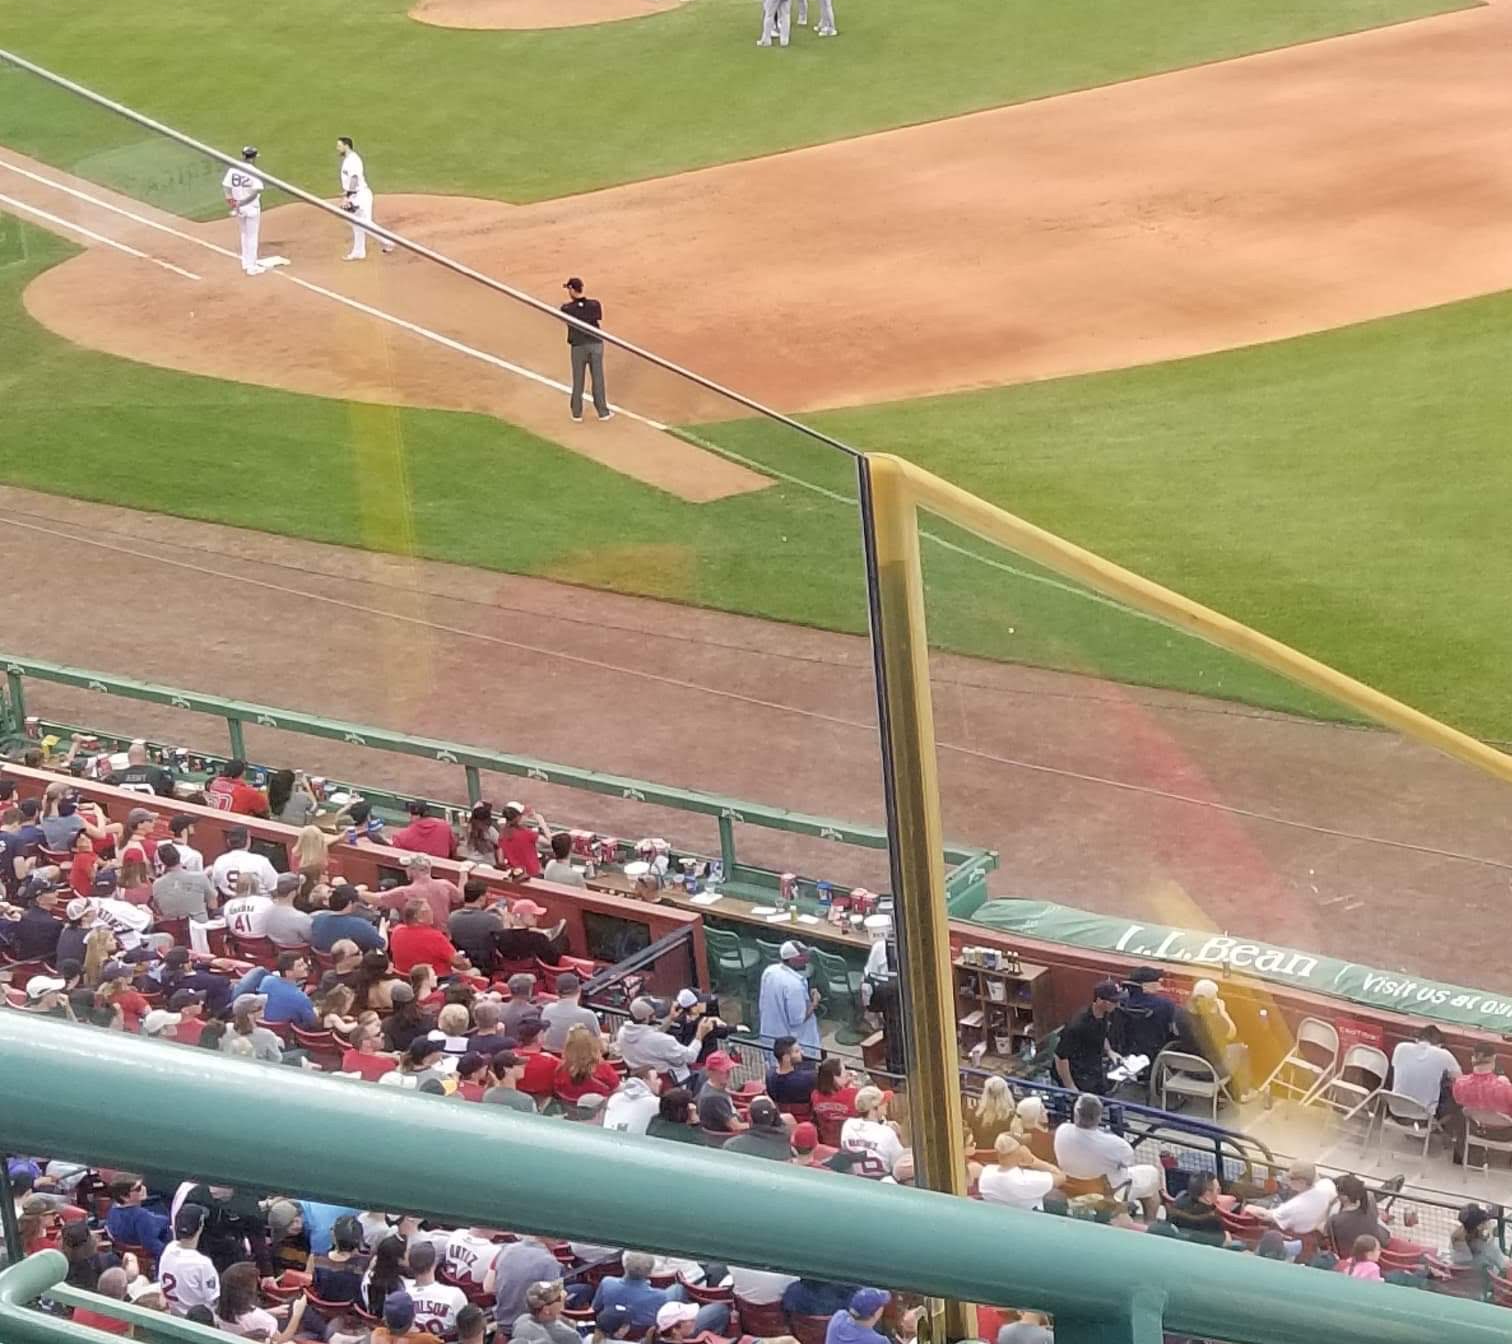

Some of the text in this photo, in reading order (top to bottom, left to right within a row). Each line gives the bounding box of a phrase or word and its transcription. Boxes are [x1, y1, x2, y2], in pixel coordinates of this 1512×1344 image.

[1362, 973, 1415, 999] Visit
[1416, 987, 1449, 1005] us
[1450, 990, 1479, 1011] at
